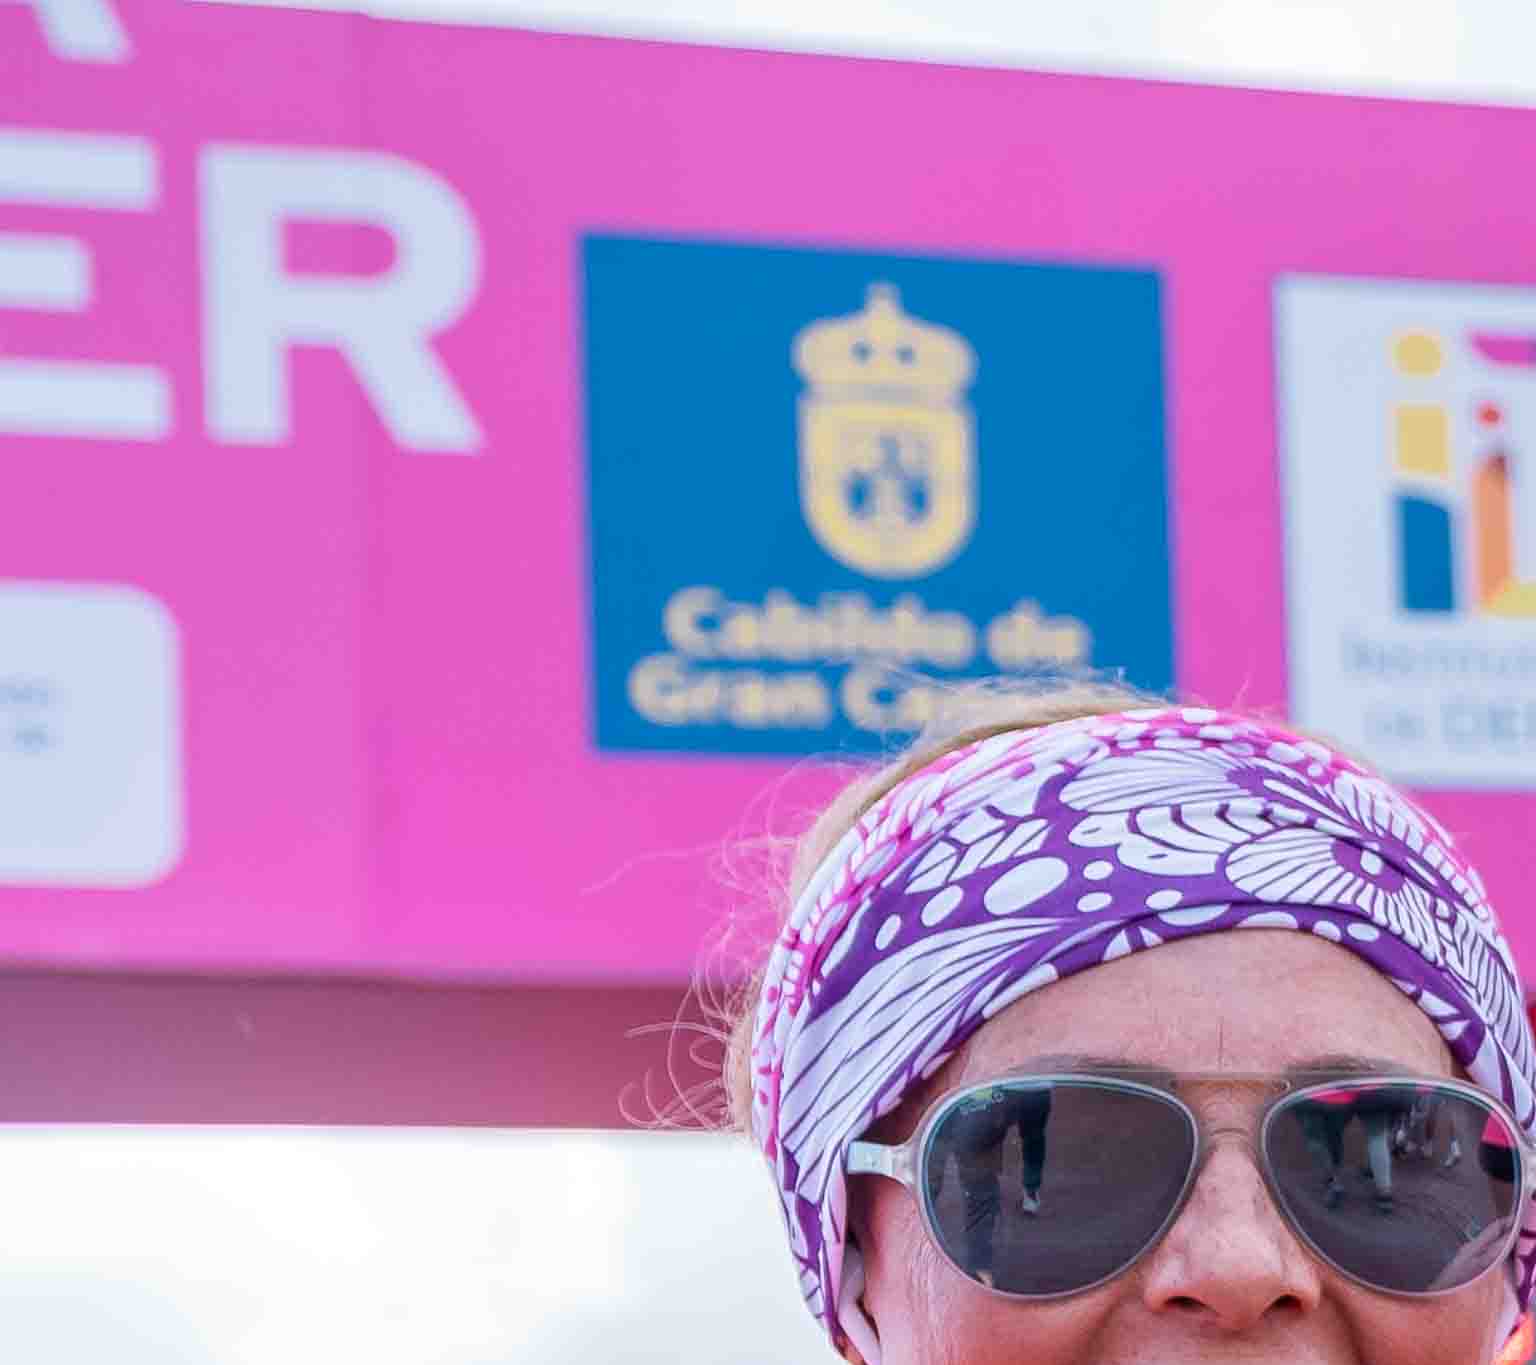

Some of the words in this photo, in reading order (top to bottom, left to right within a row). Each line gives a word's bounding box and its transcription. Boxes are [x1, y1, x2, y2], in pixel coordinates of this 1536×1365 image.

[664, 585, 976, 667] Cabildo
[987, 596, 1091, 667] de
[628, 653, 831, 729] Gran
